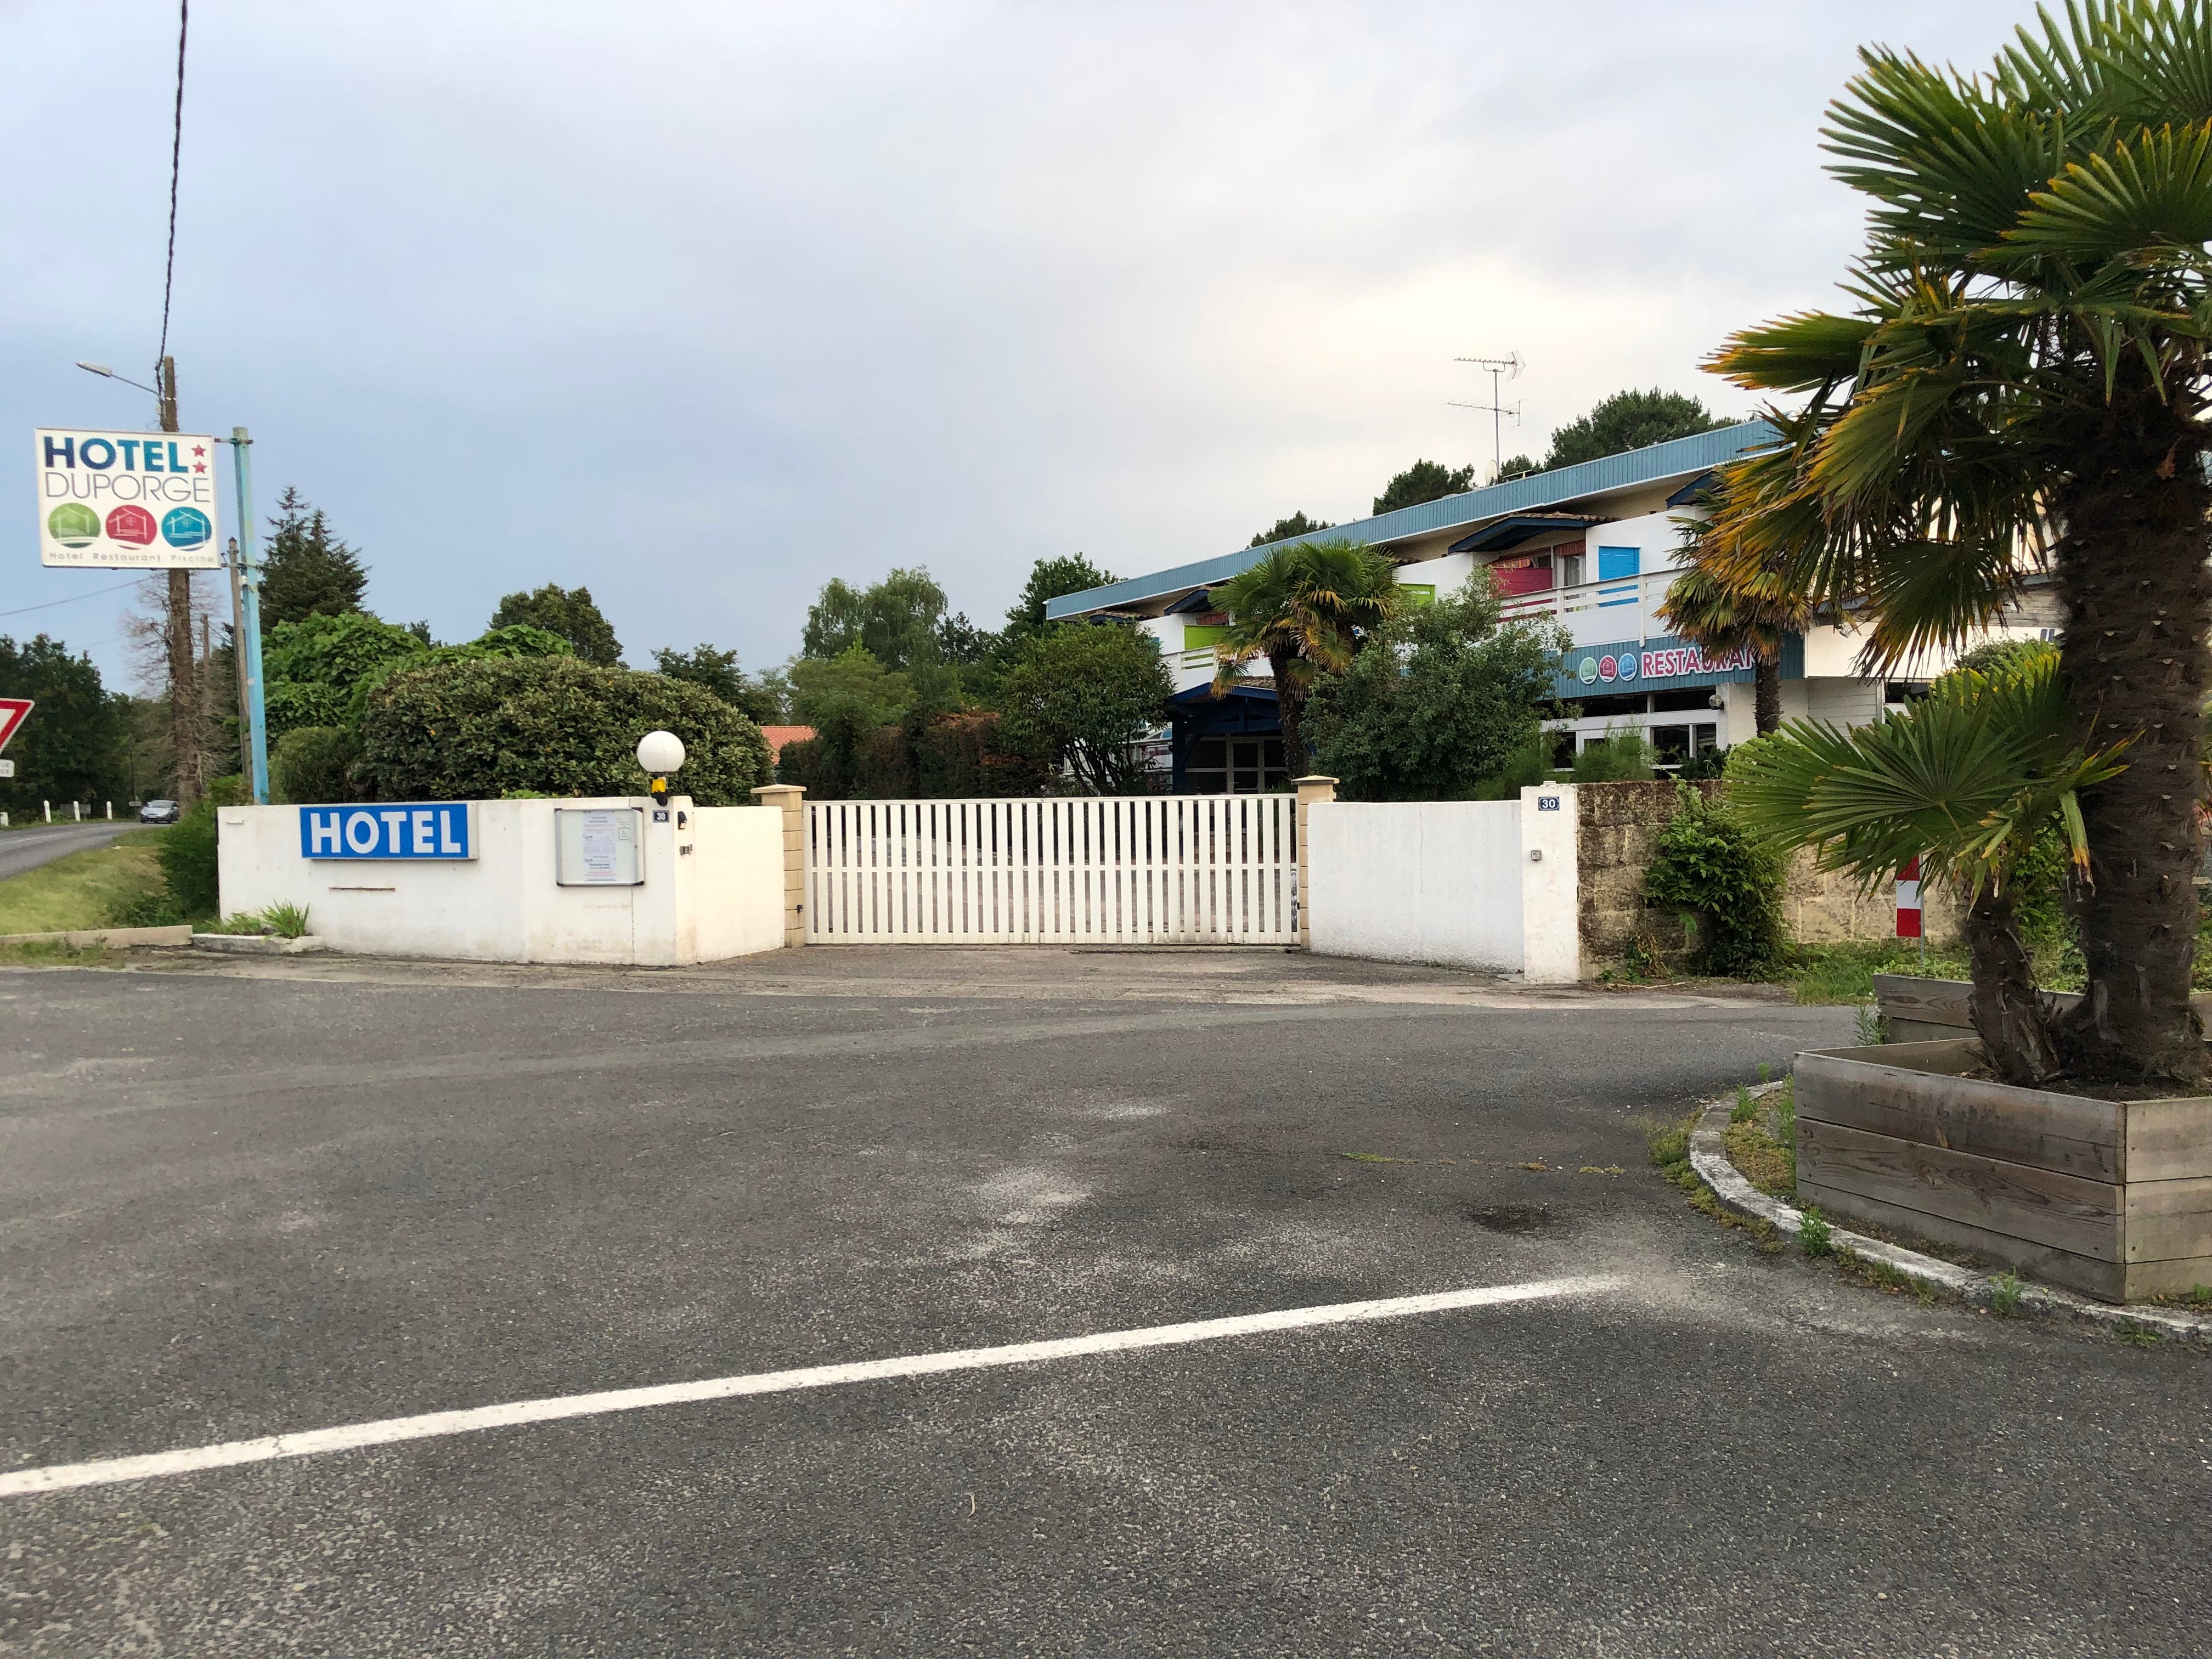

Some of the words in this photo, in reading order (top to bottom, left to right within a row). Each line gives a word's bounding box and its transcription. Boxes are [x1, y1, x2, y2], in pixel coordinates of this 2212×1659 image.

[44, 436, 189, 473] HOTEL
[45, 472, 210, 503] DUPORGE
[93, 552, 161, 562] Restaurant
[1542, 799, 1556, 809] 30
[656, 812, 666, 820] 30
[310, 810, 461, 854] HOTEL
